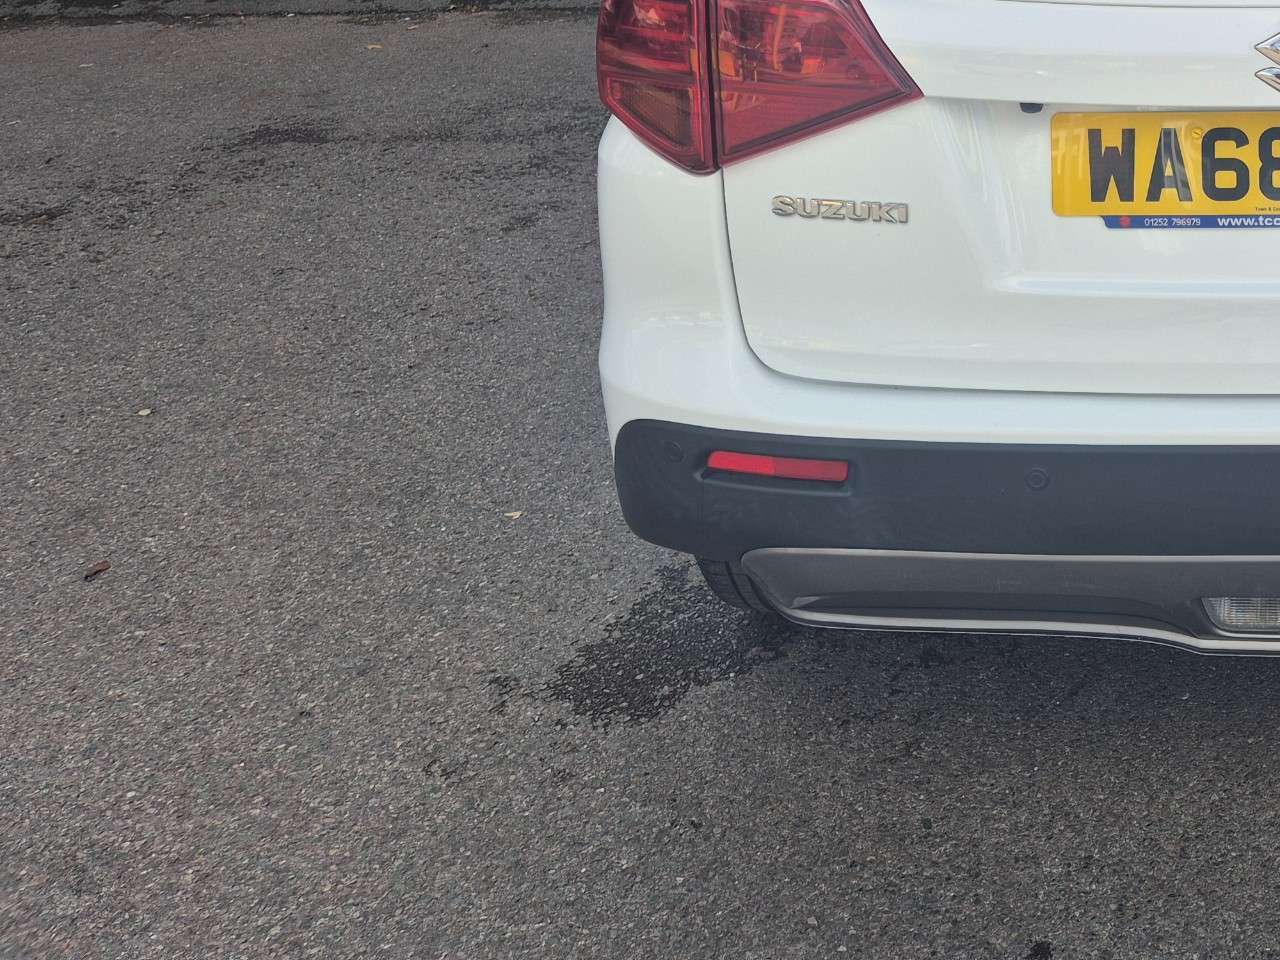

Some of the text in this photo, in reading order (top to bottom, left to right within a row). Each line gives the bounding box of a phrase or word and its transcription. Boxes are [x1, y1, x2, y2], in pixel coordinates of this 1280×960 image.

[771, 194, 909, 224] SUZUKI
[1144, 217, 1168, 227] 01252
[1171, 217, 1201, 227] 796979
